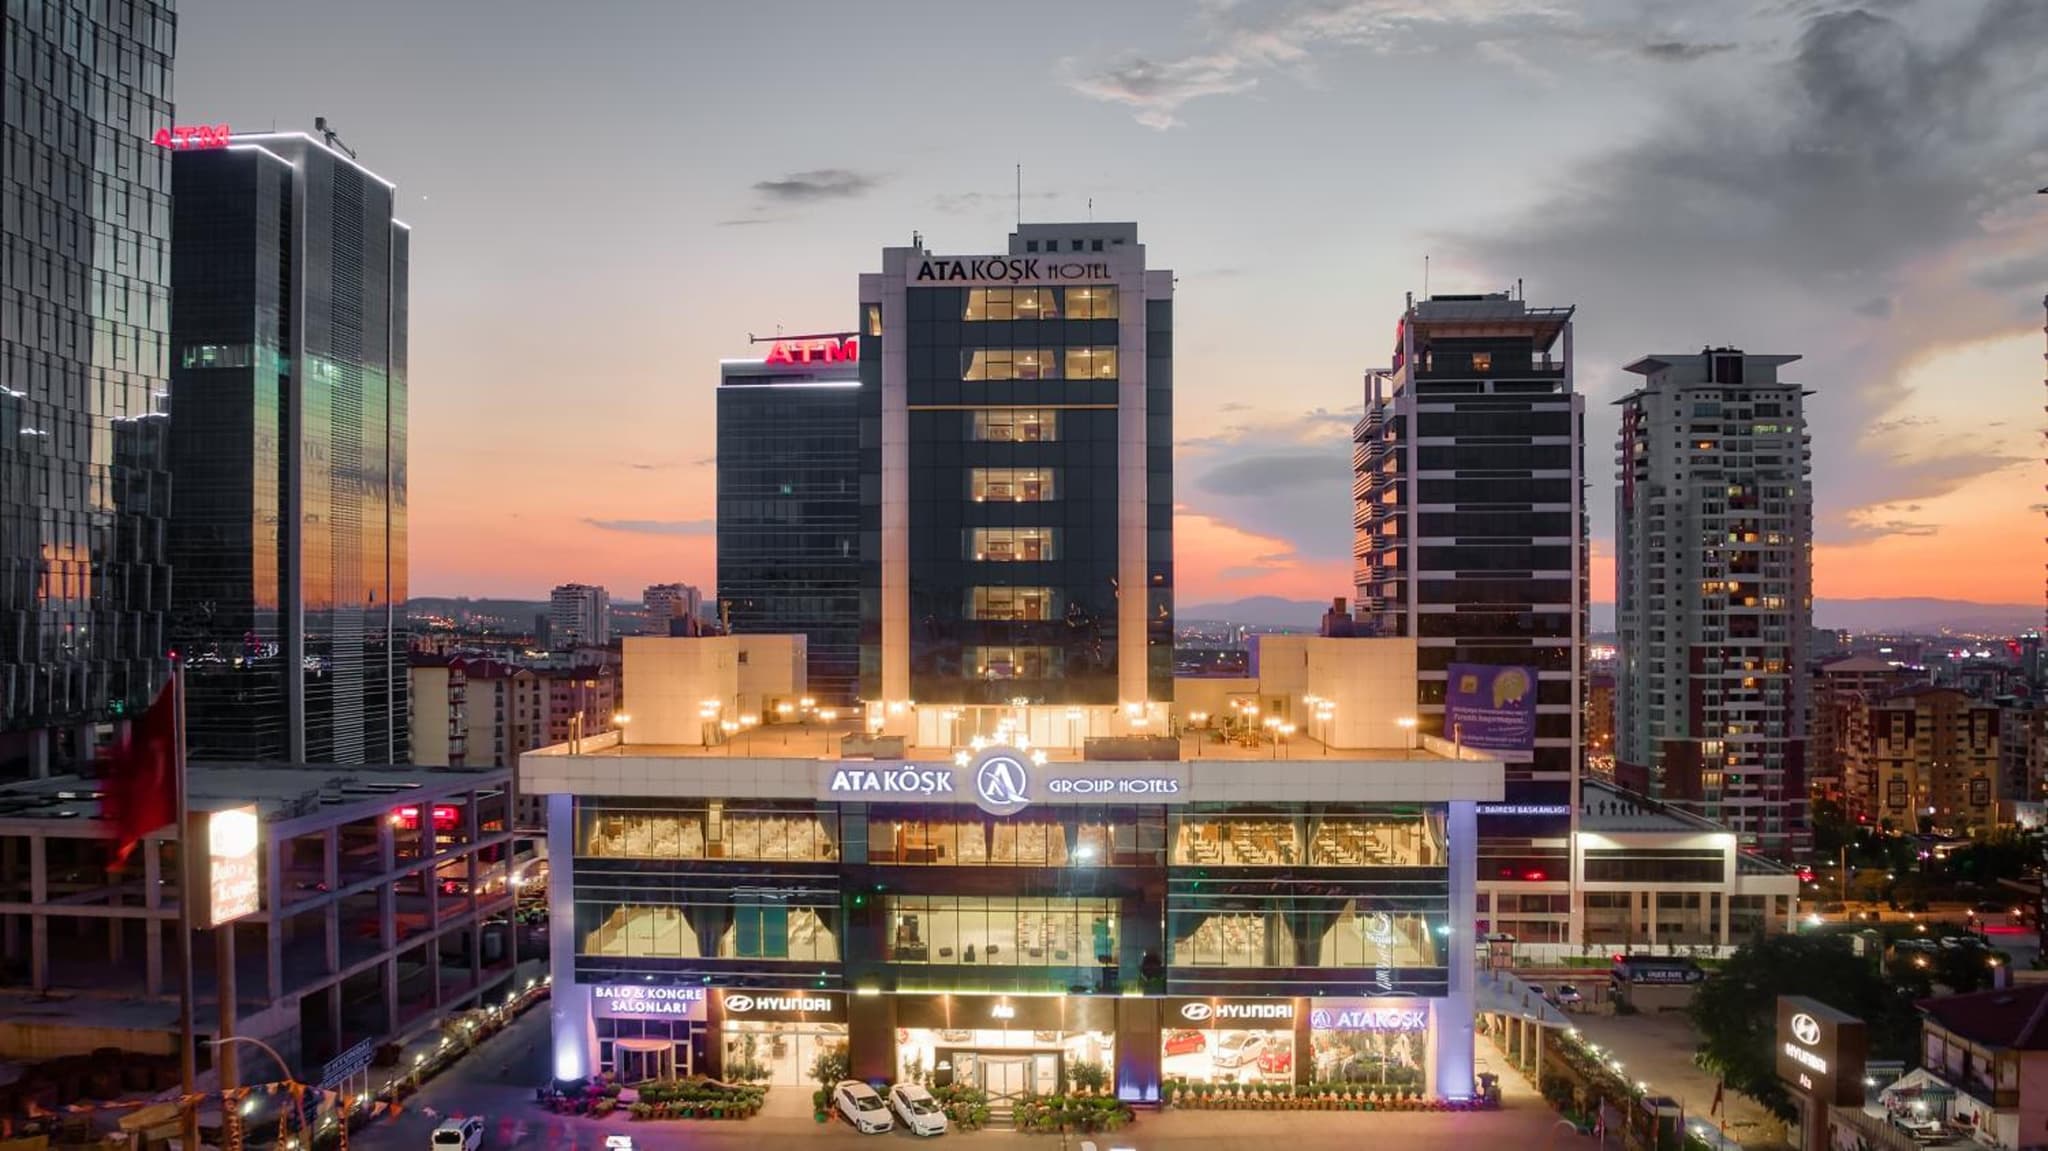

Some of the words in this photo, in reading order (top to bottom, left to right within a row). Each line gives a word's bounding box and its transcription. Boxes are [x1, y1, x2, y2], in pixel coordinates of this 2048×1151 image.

[1048, 264, 1112, 279] HOTEL
[765, 340, 858, 364] ATM
[1049, 779, 1115, 793] GROUP
[1118, 779, 1178, 793] HOTELS
[595, 987, 631, 998] BALO
[633, 988, 645, 998] &
[648, 988, 703, 1000] KONGRE
[610, 1001, 687, 1013] SALONLARI
[756, 997, 831, 1011] HYUNDAI
[1216, 1005, 1293, 1019] HYUNDAI
